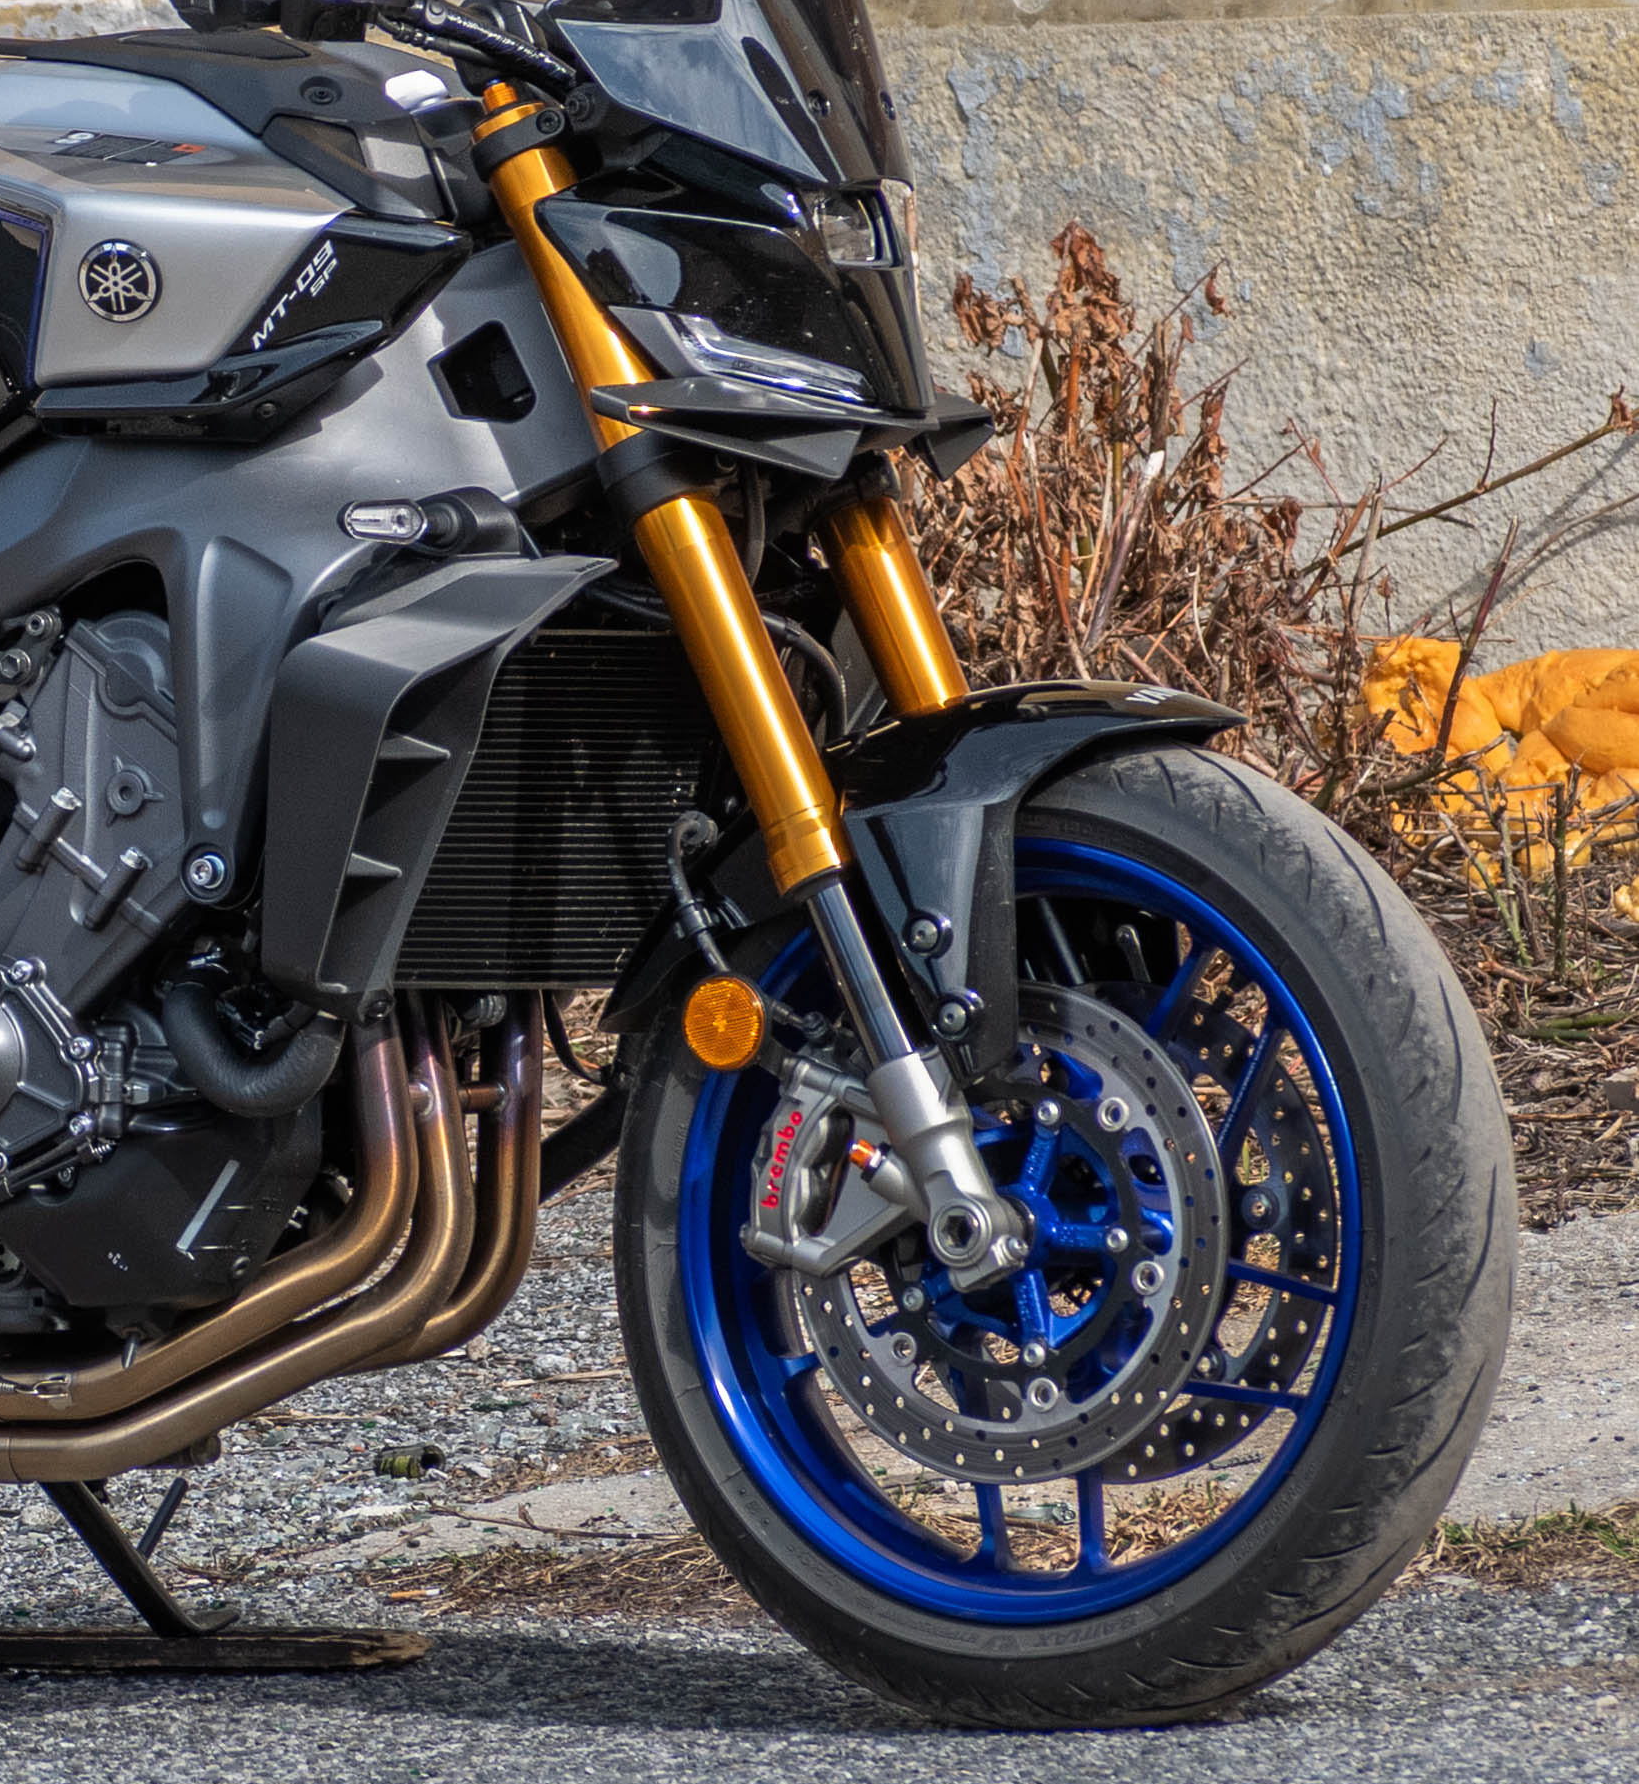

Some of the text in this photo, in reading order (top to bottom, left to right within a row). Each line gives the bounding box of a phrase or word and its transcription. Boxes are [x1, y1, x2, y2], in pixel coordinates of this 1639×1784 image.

[252, 239, 333, 350] MT-09
[310, 258, 338, 297] SP
[760, 1111, 803, 1209] brembo
